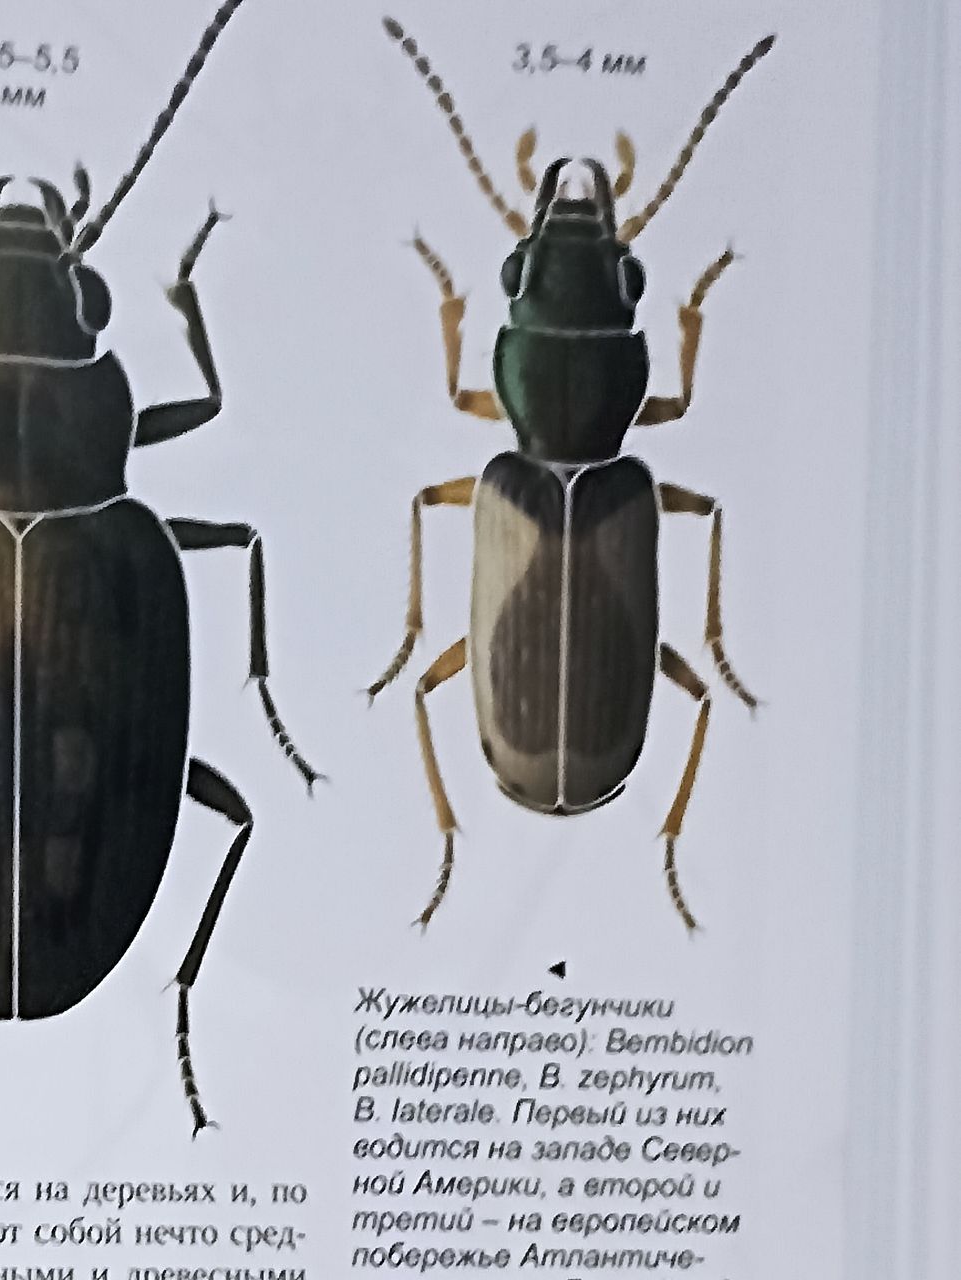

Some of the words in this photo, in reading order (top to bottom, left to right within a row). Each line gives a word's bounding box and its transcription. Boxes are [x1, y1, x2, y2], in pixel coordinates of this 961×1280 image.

[600, 52, 648, 76] мм
[0, 84, 47, 109] мм
[353, 986, 676, 1025] Жужелицы-бегунчики
[354, 1023, 450, 1056] (слева
[457, 1027, 596, 1060] направо):
[605, 1026, 754, 1057] Bembidion
[351, 1059, 528, 1093] pallidipenne,
[538, 1061, 566, 1091] B.
[577, 1064, 721, 1096] zephyrum,
[352, 1131, 481, 1161] водится
[487, 1138, 523, 1161] на
[530, 1133, 632, 1163] западе
[640, 1133, 742, 1168] Север-
[34, 1180, 70, 1203] на
[81, 1180, 217, 1211] деревьях
[230, 1183, 257, 1208] и,
[271, 1182, 308, 1205] по
[33, 1215, 123, 1246] собой
[134, 1223, 219, 1247] нечто
[229, 1223, 307, 1253] сред-
[351, 1240, 512, 1274] побережье
[518, 1241, 706, 1271] Атлантиче-
